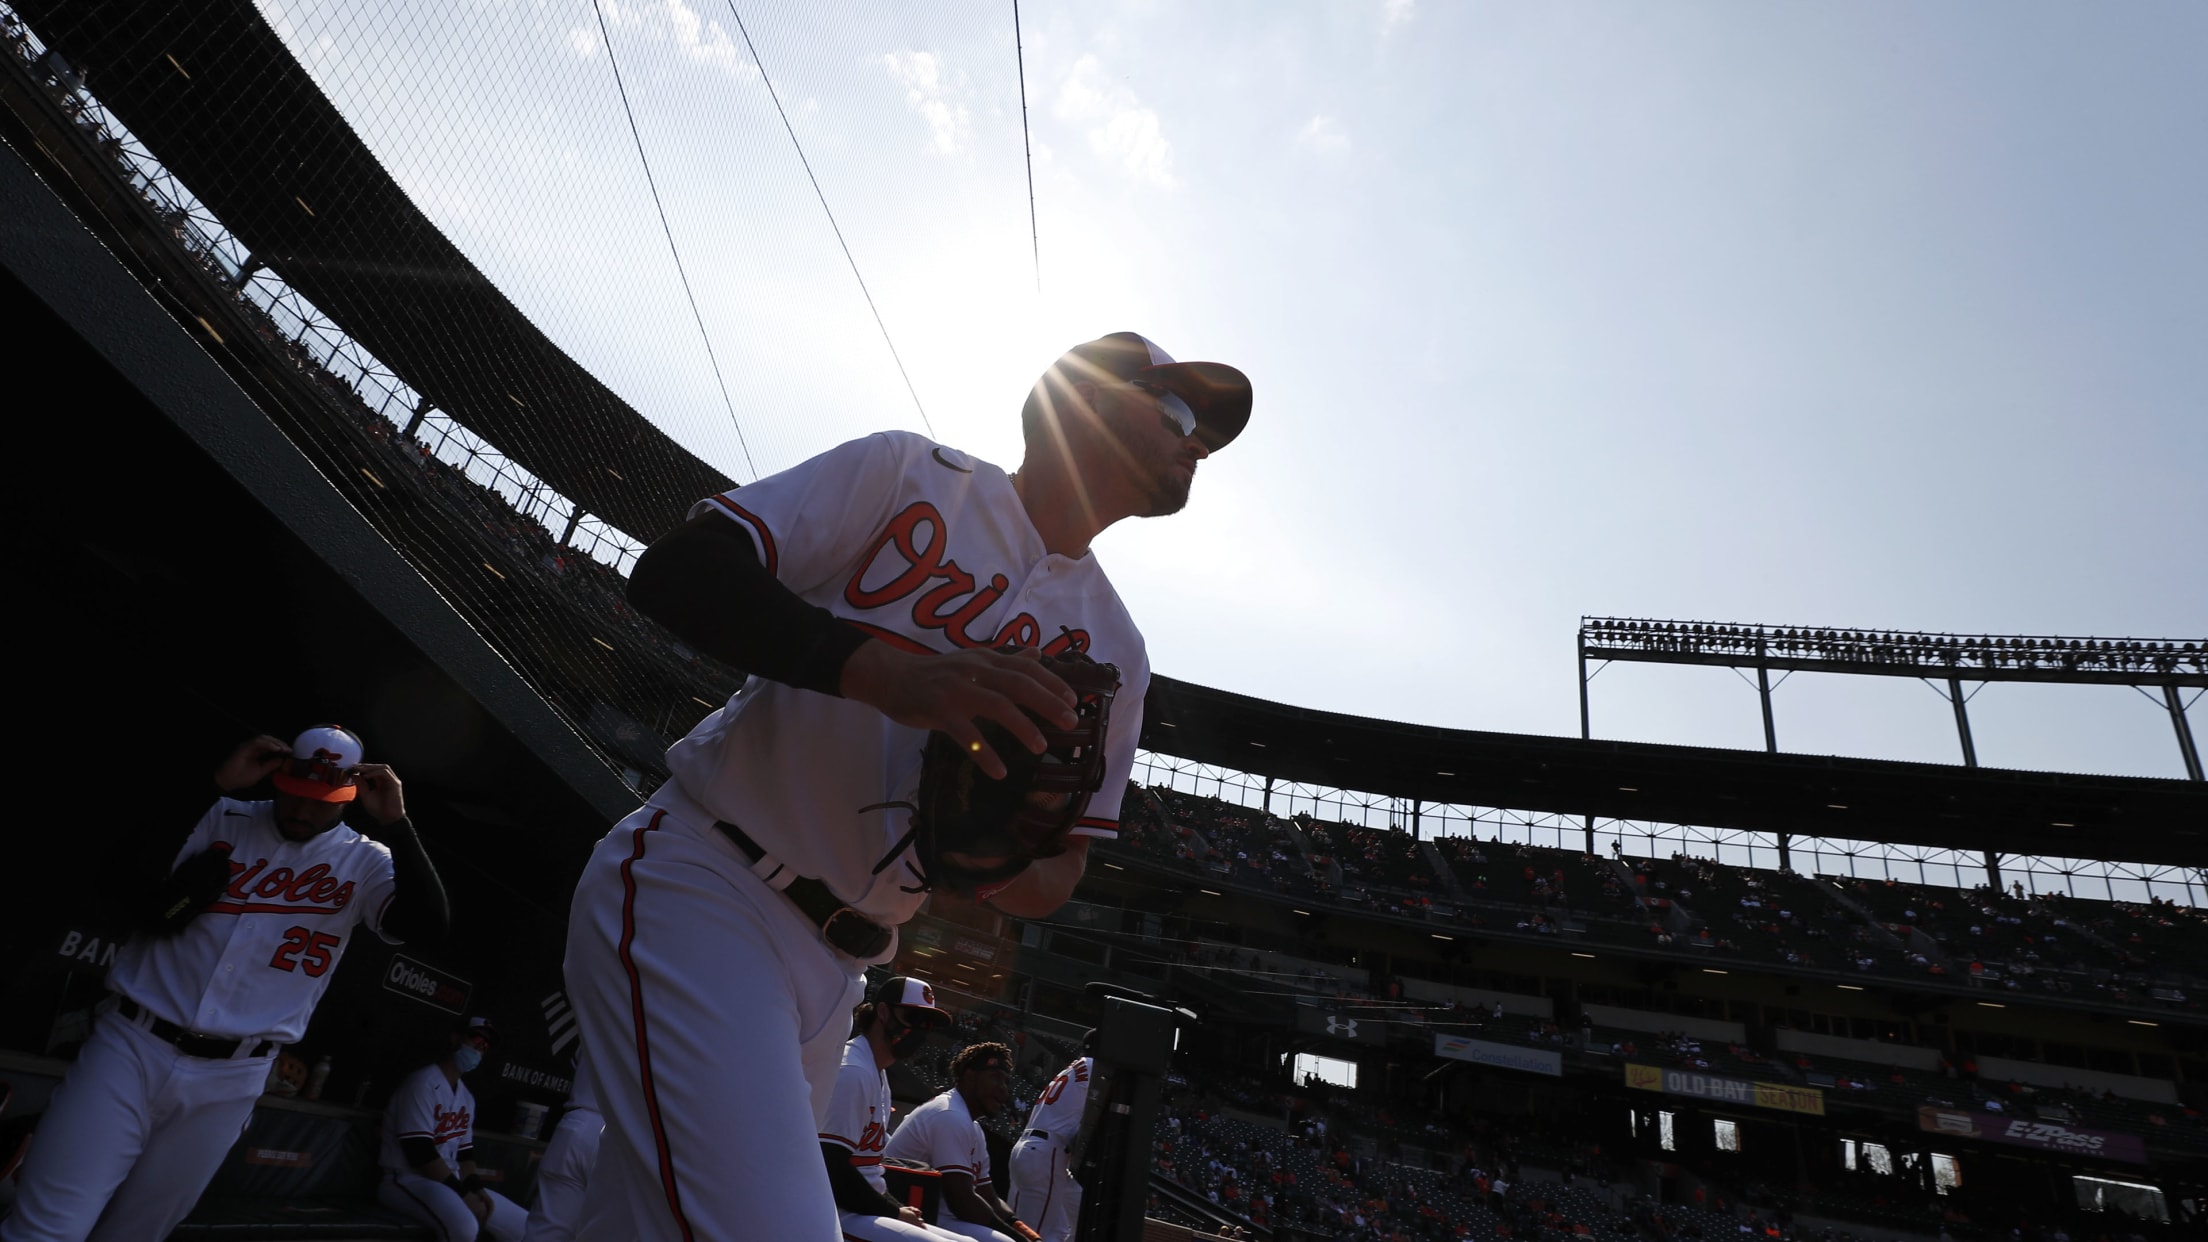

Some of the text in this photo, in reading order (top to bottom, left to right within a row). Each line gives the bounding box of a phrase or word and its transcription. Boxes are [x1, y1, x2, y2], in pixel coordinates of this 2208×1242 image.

[269, 926, 341, 977] 25
[501, 1062, 532, 1084] BANK
[530, 1070, 545, 1086] OF
[1472, 1049, 1553, 1073] Constellation
[1668, 1073, 1705, 1095] OLD
[1710, 1077, 1748, 1101] BAY
